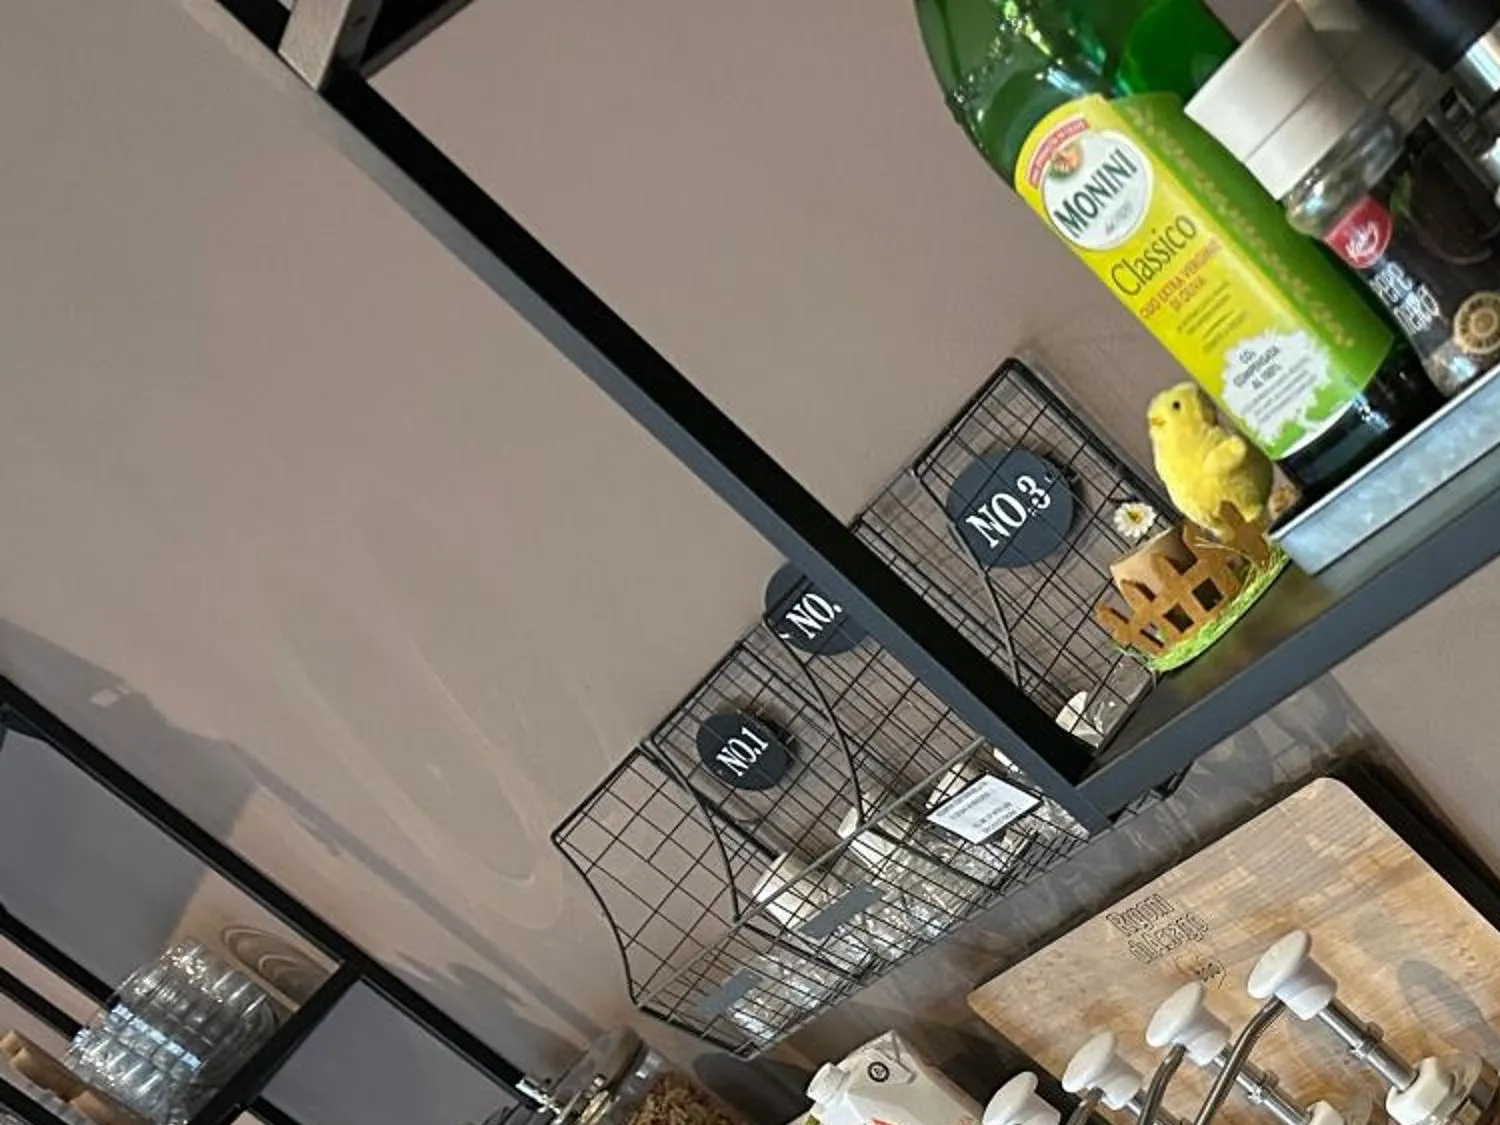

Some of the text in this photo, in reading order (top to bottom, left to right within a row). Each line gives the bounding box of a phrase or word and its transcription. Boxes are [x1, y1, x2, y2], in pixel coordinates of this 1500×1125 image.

[1053, 148, 1138, 239] MONINI
[1112, 214, 1197, 296] Classico
[785, 593, 842, 640] NO.
[715, 726, 769, 777] NO.1
